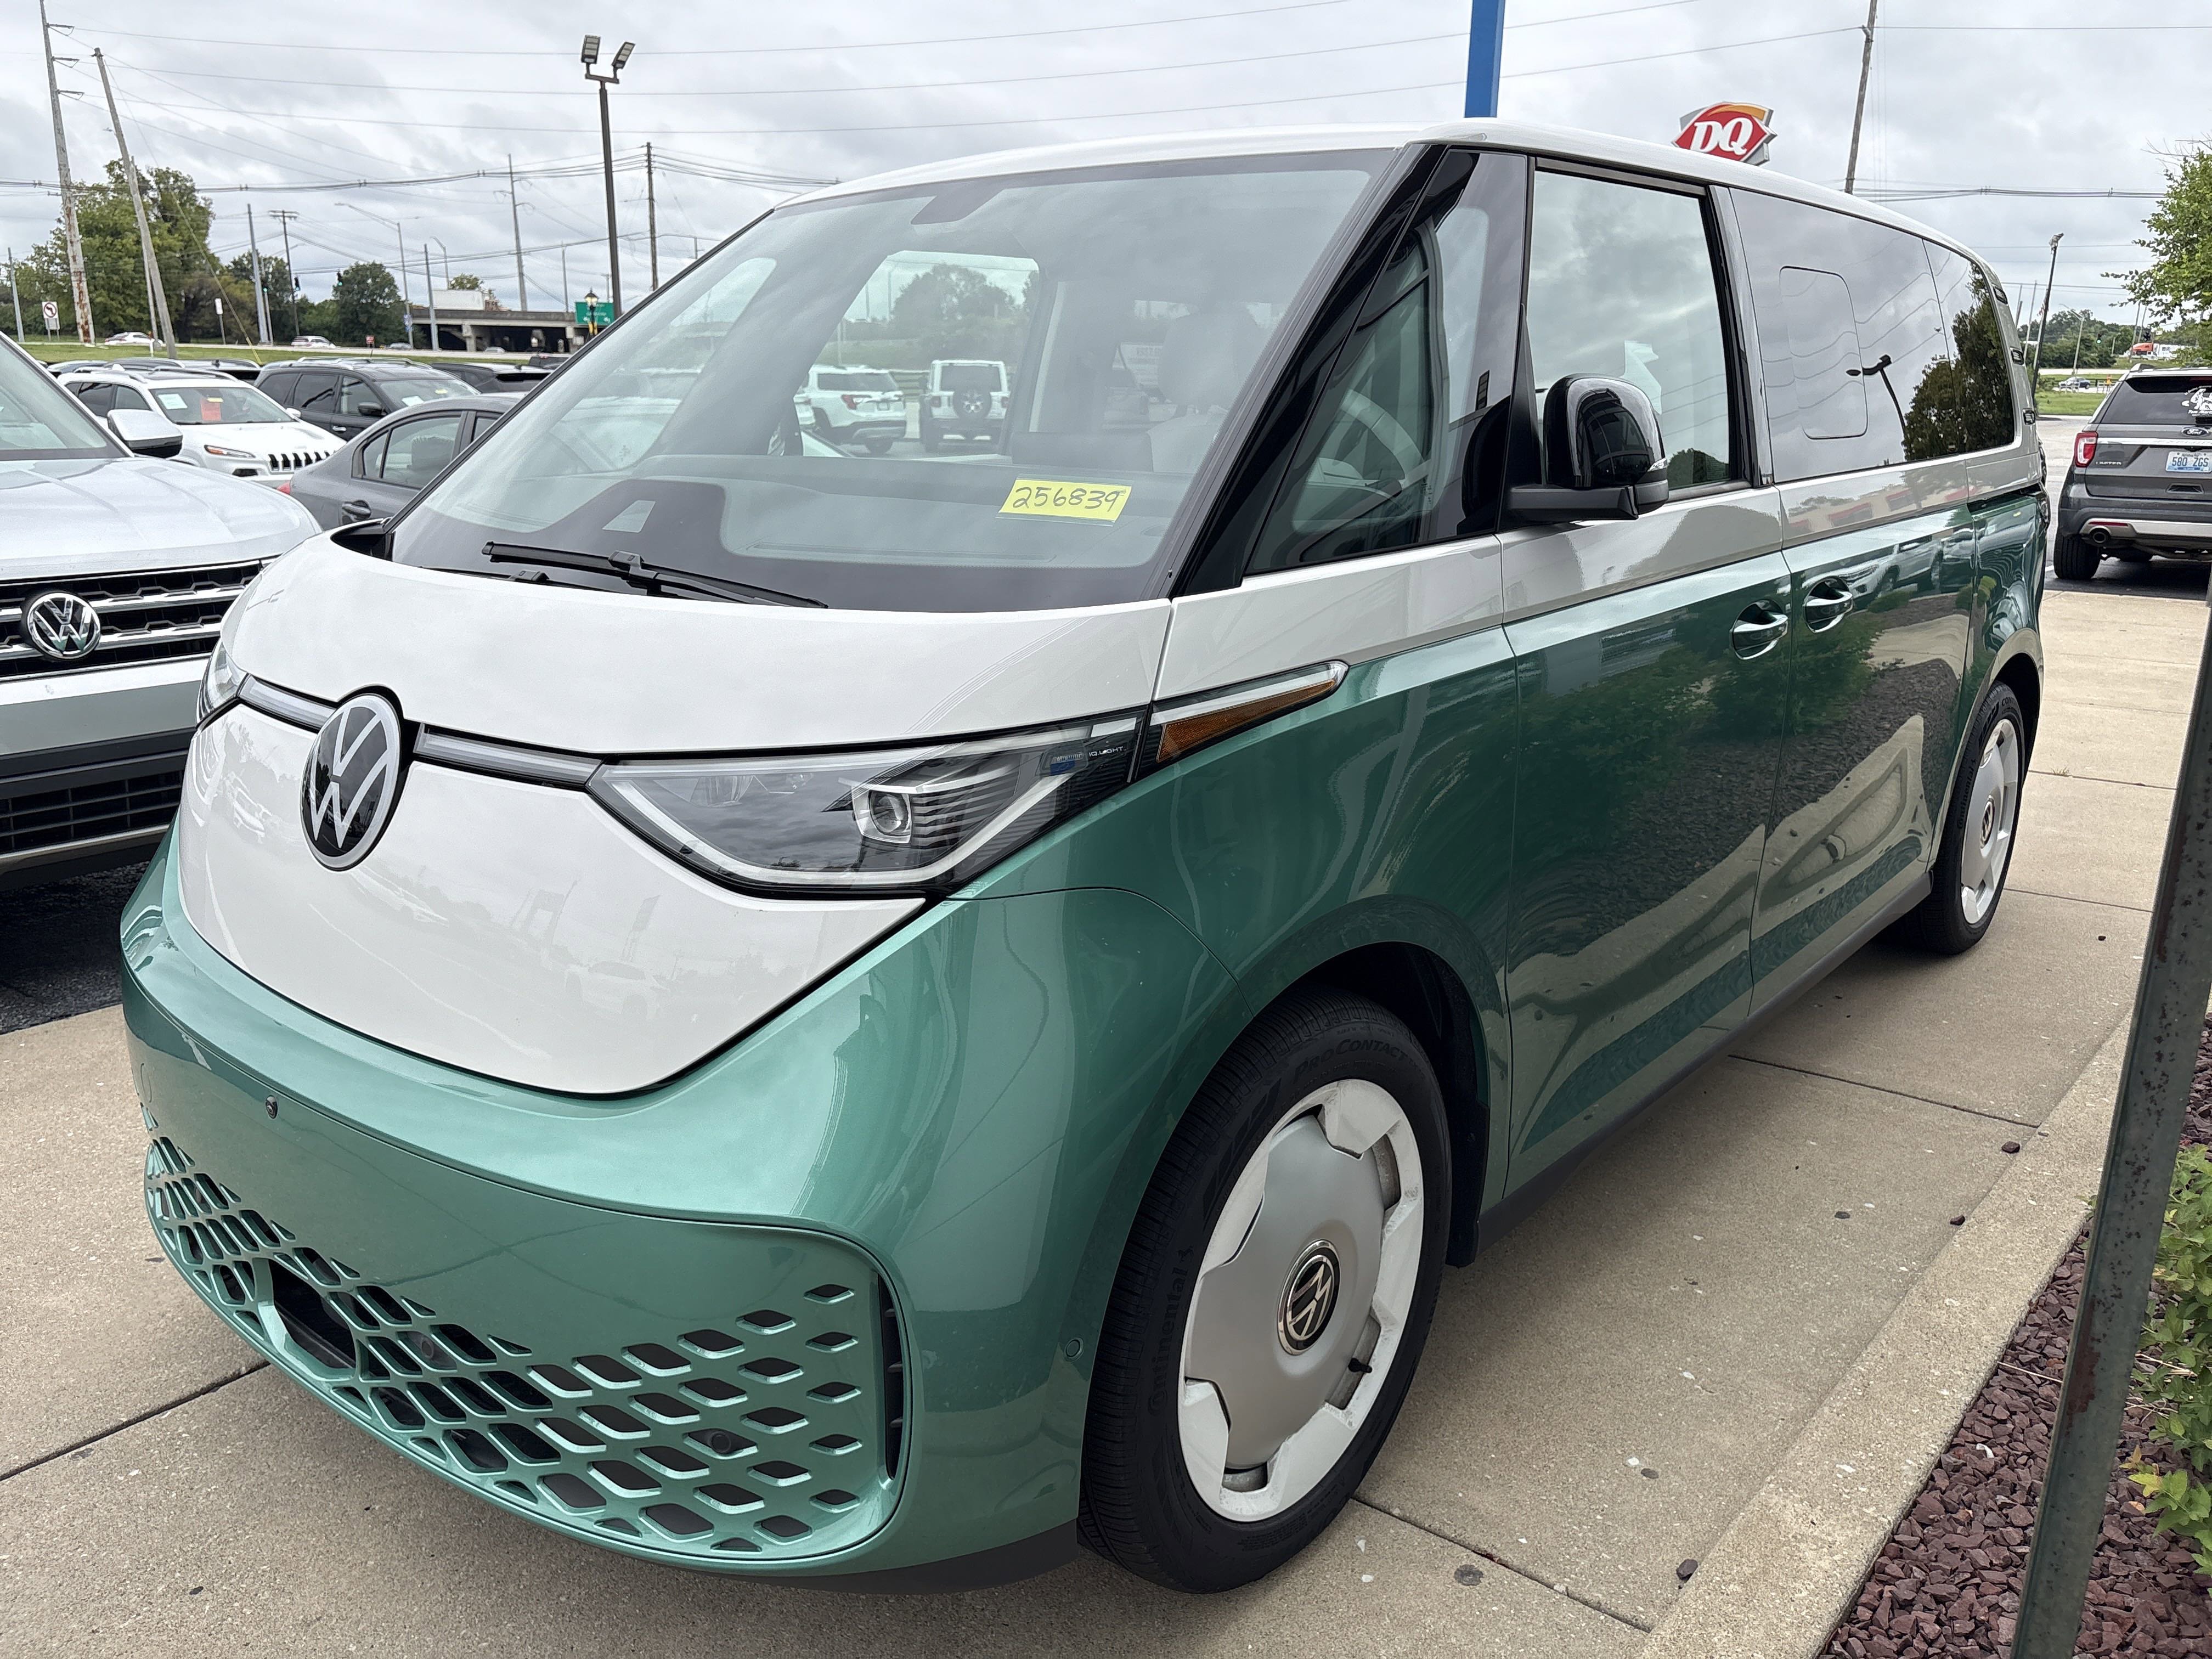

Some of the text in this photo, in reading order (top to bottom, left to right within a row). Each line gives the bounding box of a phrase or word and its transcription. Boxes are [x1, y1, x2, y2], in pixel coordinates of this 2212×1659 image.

[1690, 117, 1753, 155] DQ
[2171, 456, 2209, 467] 580 ZGS
[1013, 487, 1121, 512] 256839
[31, 595, 97, 656] VW
[305, 699, 395, 861] VW
[1088, 746, 1124, 757] IQ.LGHT
[1957, 766, 1975, 830] Continental
[1285, 1254, 1335, 1342] VW
[1147, 1267, 1188, 1418] Continental
